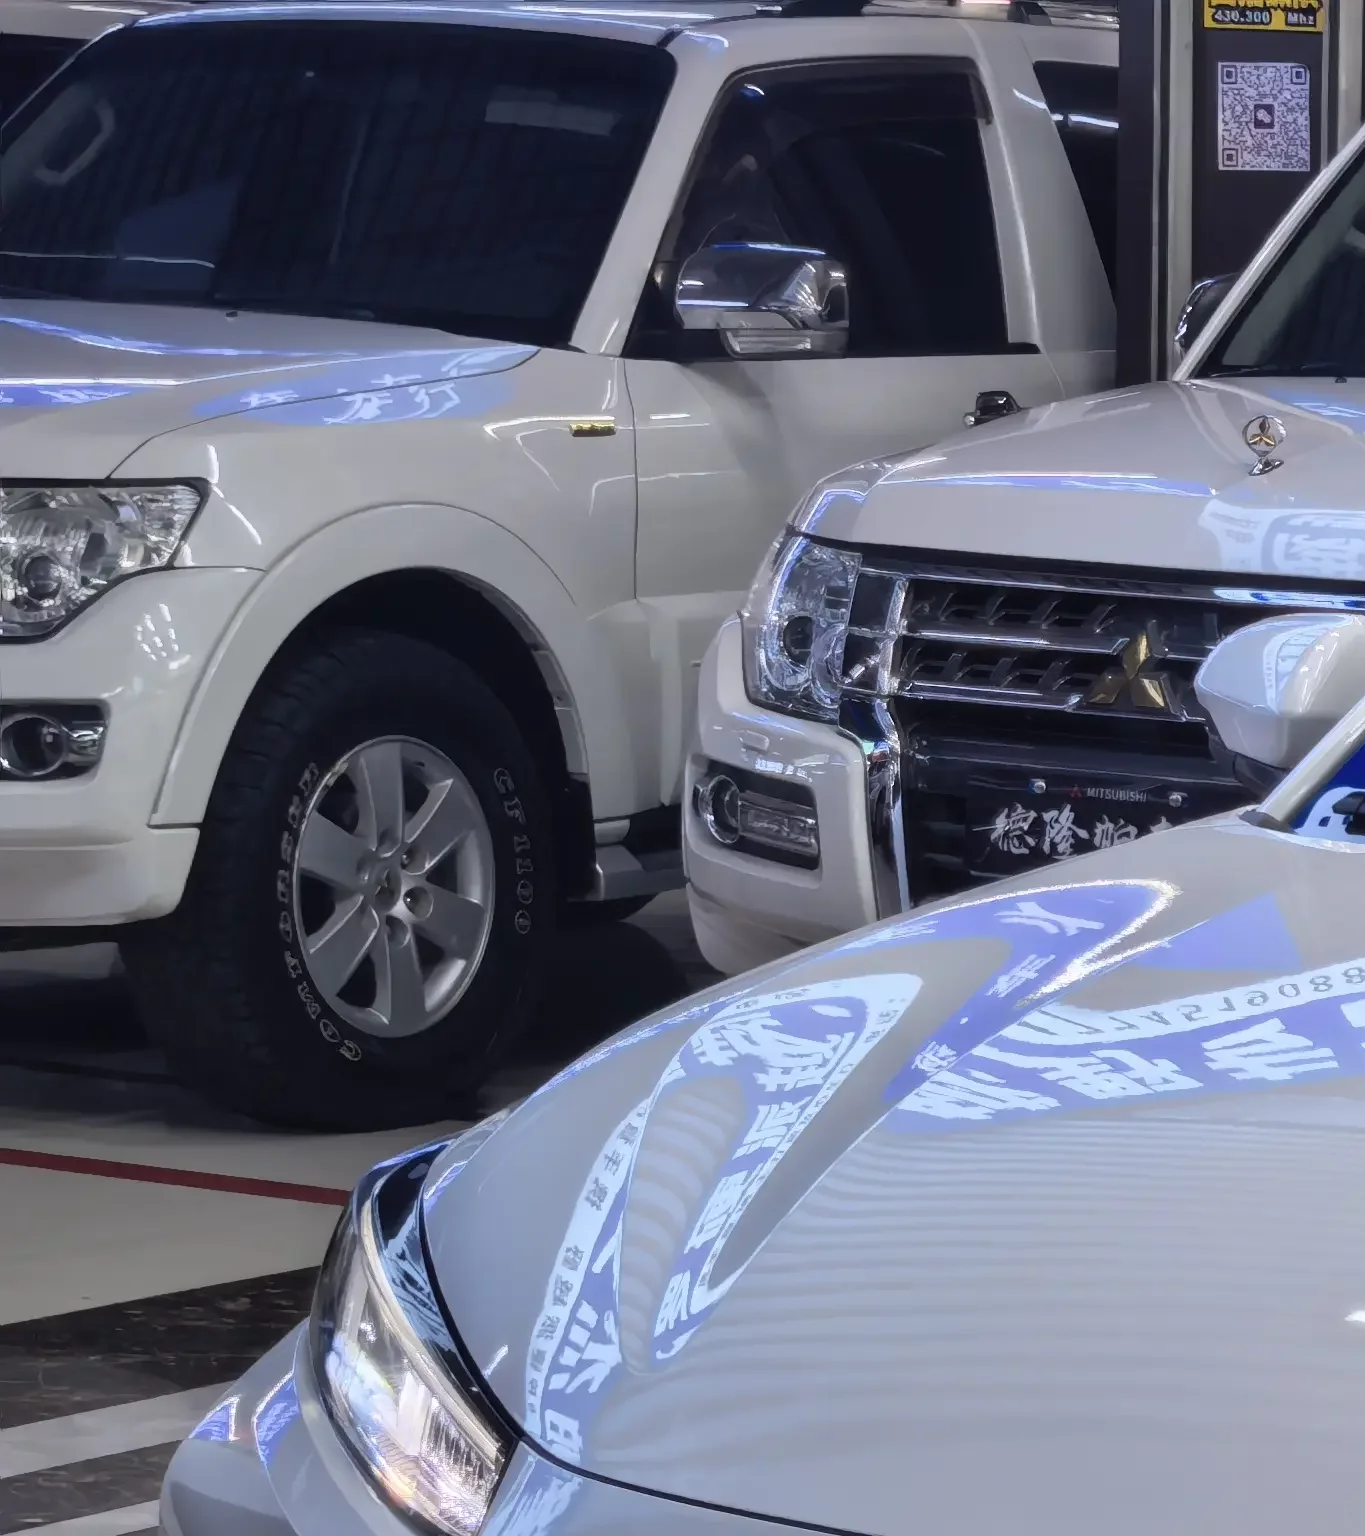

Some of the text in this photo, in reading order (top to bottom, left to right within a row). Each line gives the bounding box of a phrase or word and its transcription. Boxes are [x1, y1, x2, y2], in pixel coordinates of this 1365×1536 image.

[1086, 787, 1148, 803] MITSUBISHI
[990, 801, 1174, 860] 德隆帕
